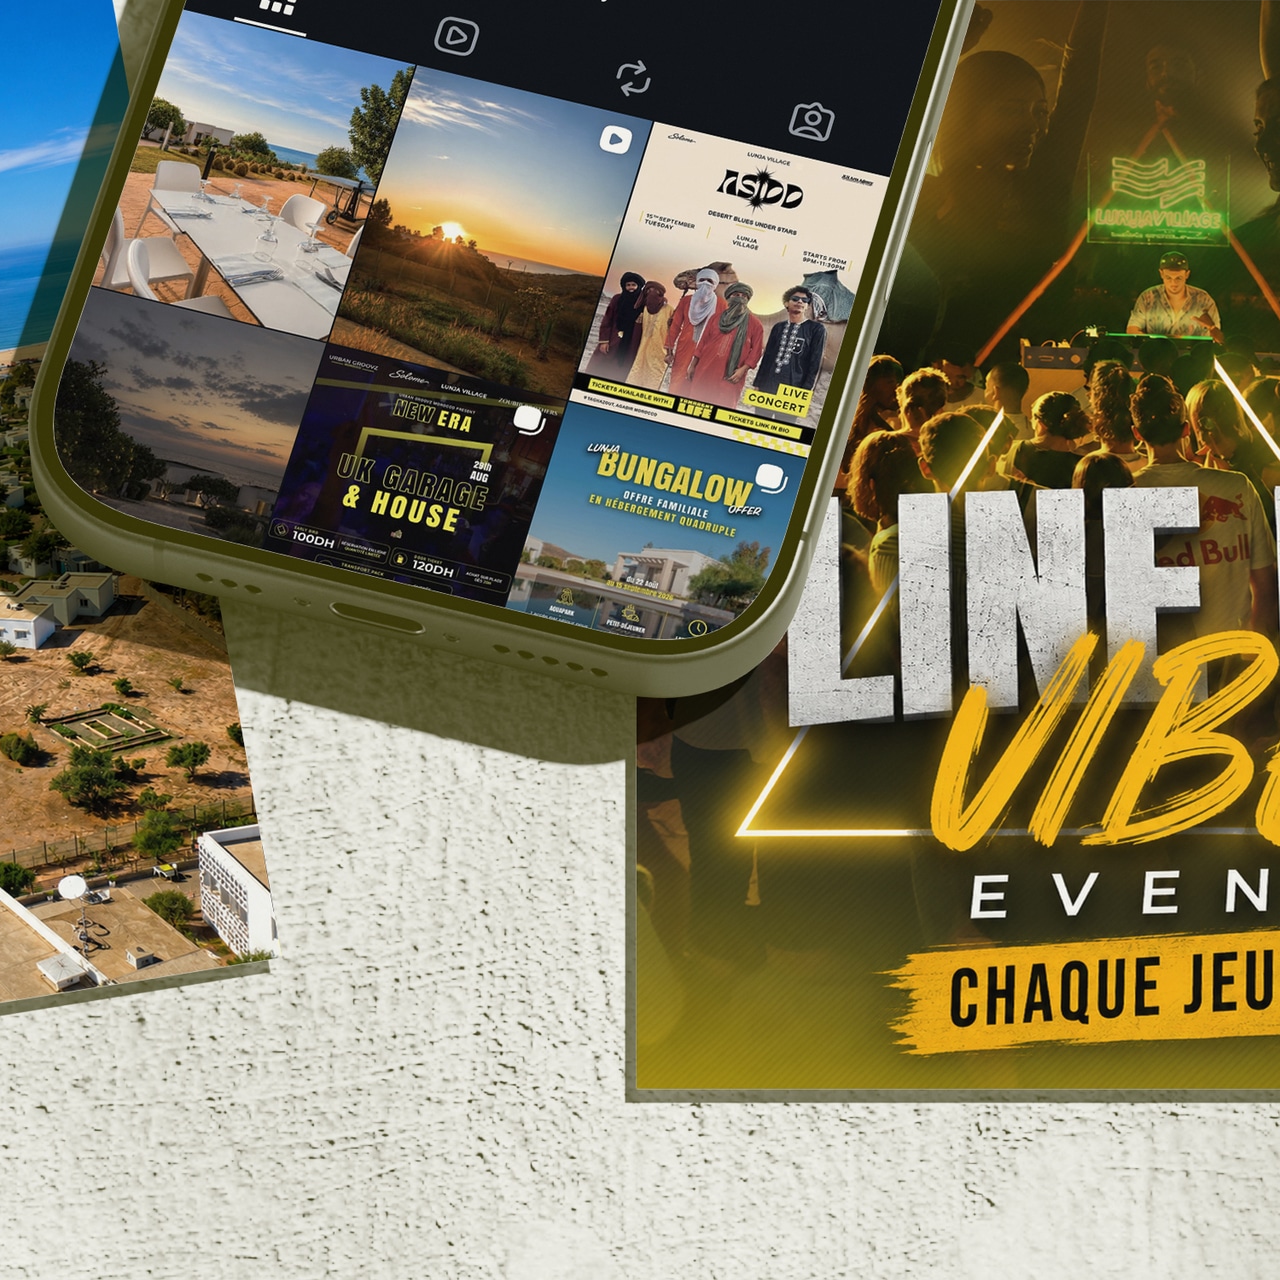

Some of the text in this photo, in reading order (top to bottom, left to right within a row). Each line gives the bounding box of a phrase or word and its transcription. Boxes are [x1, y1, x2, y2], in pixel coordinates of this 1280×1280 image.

[747, 151, 790, 166] LUNJA VILLAGE
[645, 218, 673, 229] TUESDAY
[658, 216, 695, 229] SEPTEMBER
[707, 209, 797, 235] DESERT BLUES UNDER STARS
[732, 239, 758, 250] VILLAGE
[736, 235, 757, 244] LUNJA
[803, 250, 846, 264] STARTS FROM
[328, 354, 351, 364] URBAN
[440, 383, 487, 399] LUNJA VILLAGE
[592, 381, 669, 404] TICKETS AVAILABLE WITH
[782, 386, 809, 400] LIVE
[748, 393, 805, 413] CONCERT
[392, 399, 471, 432] NEW ERA
[728, 414, 754, 425] TICKETS
[754, 421, 769, 429] LINK
[587, 443, 621, 454] LUNJA
[473, 460, 492, 471] 29th
[336, 453, 489, 511] UK GARAGE
[469, 470, 488, 482] AUG
[596, 452, 754, 507] BUNGALOW
[342, 484, 460, 532] & HOUSE
[623, 490, 709, 519] OFFRE FAMILIALE
[727, 505, 762, 516] OFFER
[589, 494, 737, 538] EN HÉBERGEMENT QUADRUPLE
[293, 530, 334, 548] 100DH
[1157, 533, 1250, 567] ed Bull
[413, 559, 454, 577] 120DH
[787, 485, 1201, 726] LINE
[949, 955, 1161, 1028] CHAQUE
